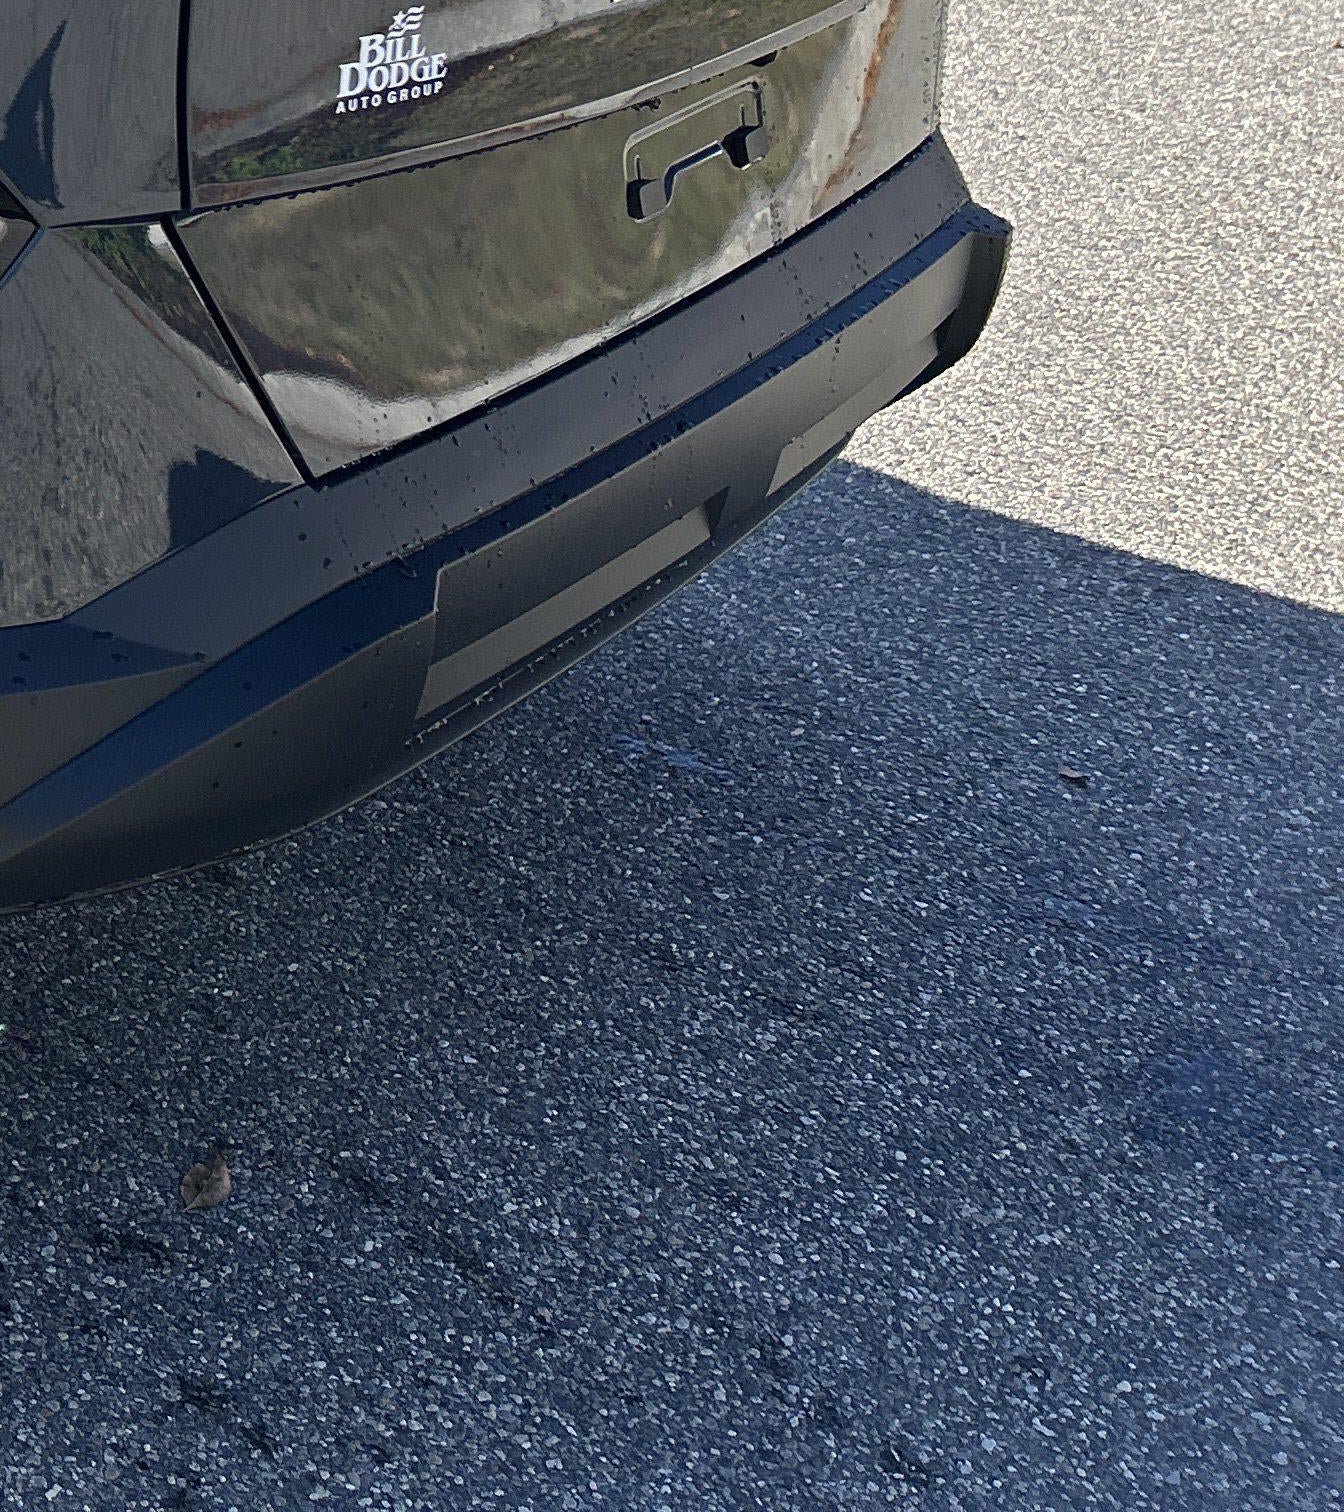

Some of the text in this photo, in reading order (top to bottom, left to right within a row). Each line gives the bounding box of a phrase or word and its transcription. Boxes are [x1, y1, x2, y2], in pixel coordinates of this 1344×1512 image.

[359, 33, 427, 69] BILL
[336, 52, 448, 99] DODGE
[335, 80, 444, 115] AUTO GROUP
